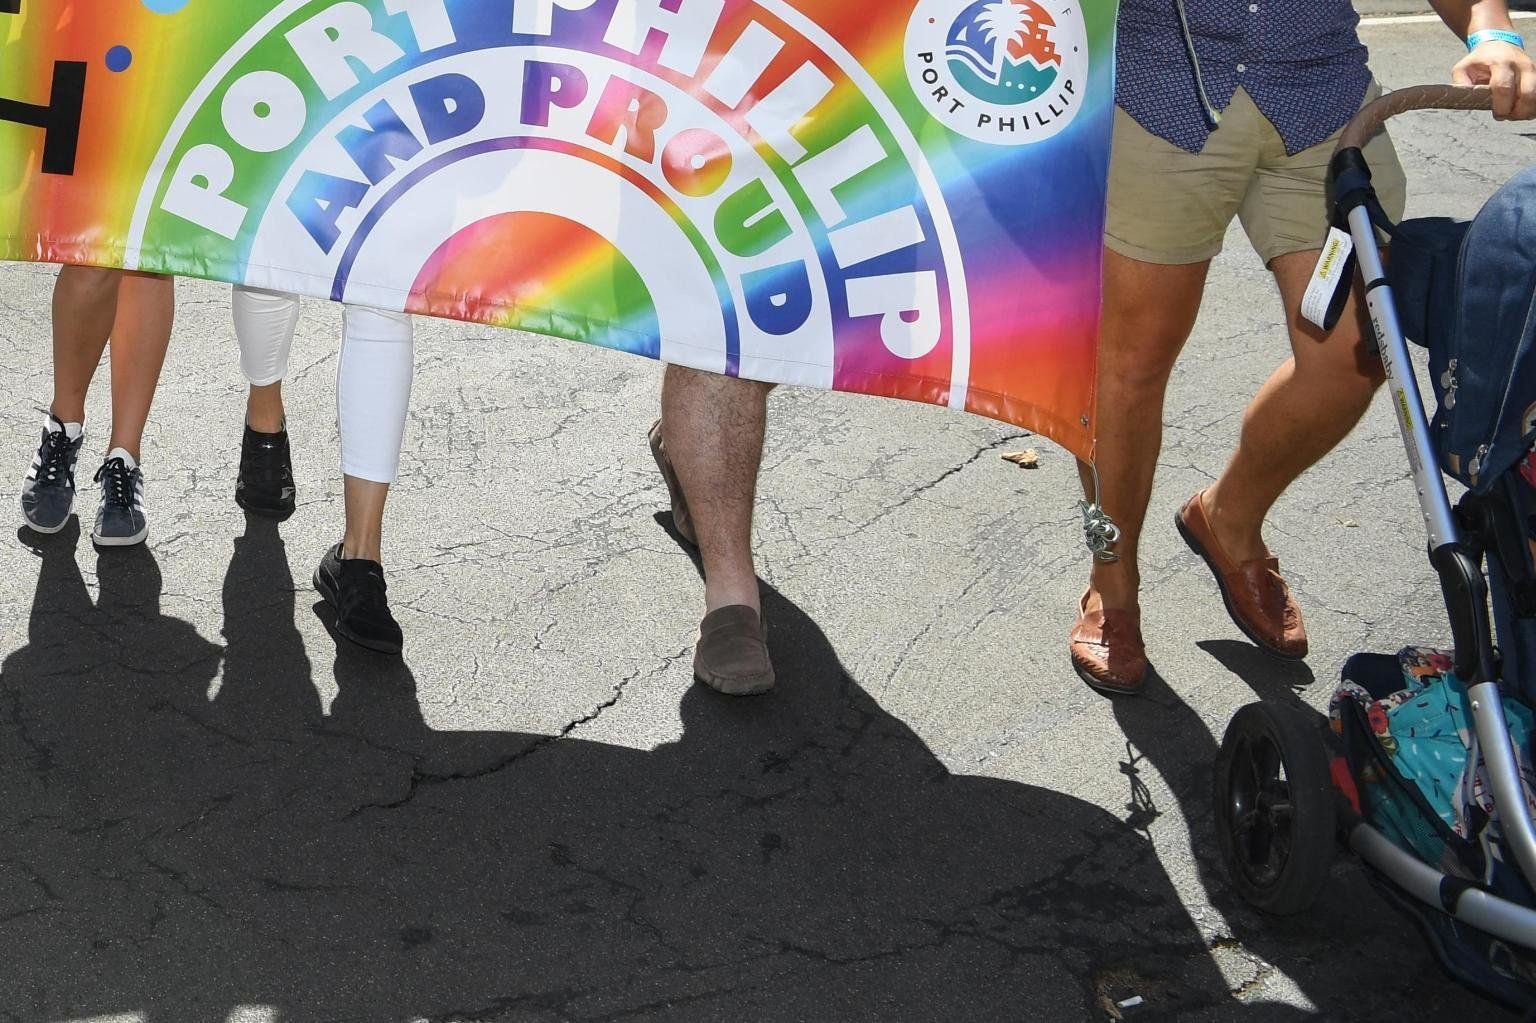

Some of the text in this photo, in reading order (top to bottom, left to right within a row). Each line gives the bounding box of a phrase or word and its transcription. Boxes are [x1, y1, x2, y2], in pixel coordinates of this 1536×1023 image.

[917, 51, 1076, 132] PORT PHILLIP
[284, 59, 814, 338] AND PROUD
